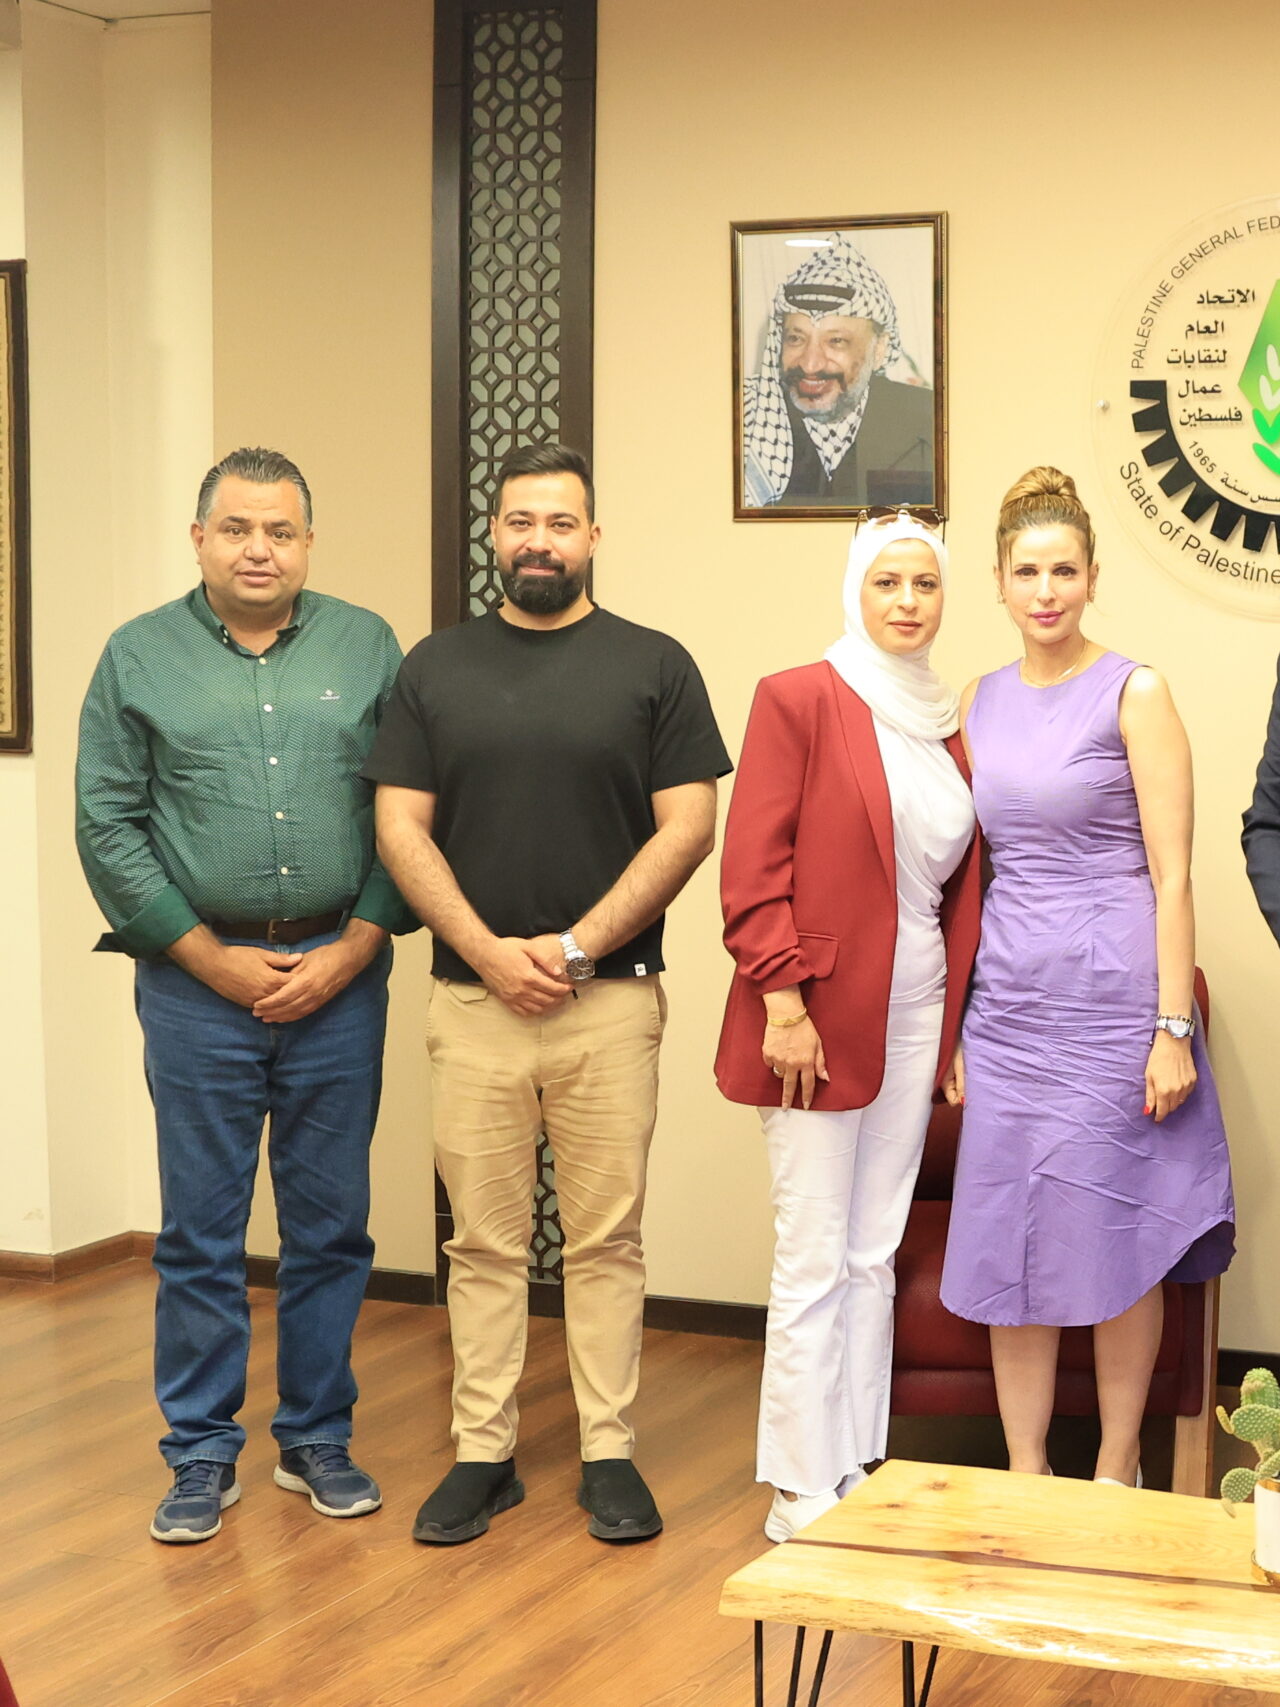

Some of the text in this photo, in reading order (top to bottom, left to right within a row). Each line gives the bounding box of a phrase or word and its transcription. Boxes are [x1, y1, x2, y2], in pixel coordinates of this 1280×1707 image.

[1131, 280, 1174, 369] PALESTINE
[1170, 226, 1244, 280] GENERAL
[1185, 320, 1224, 339] العام
[1167, 349, 1227, 368] لنقابات
[1178, 380, 1222, 398] عمال
[1179, 407, 1243, 427] فلسطين
[1188, 440, 1217, 474] 1965
[1220, 472, 1249, 496] سنة
[1120, 461, 1158, 519] State
[1159, 520, 1184, 541] of
